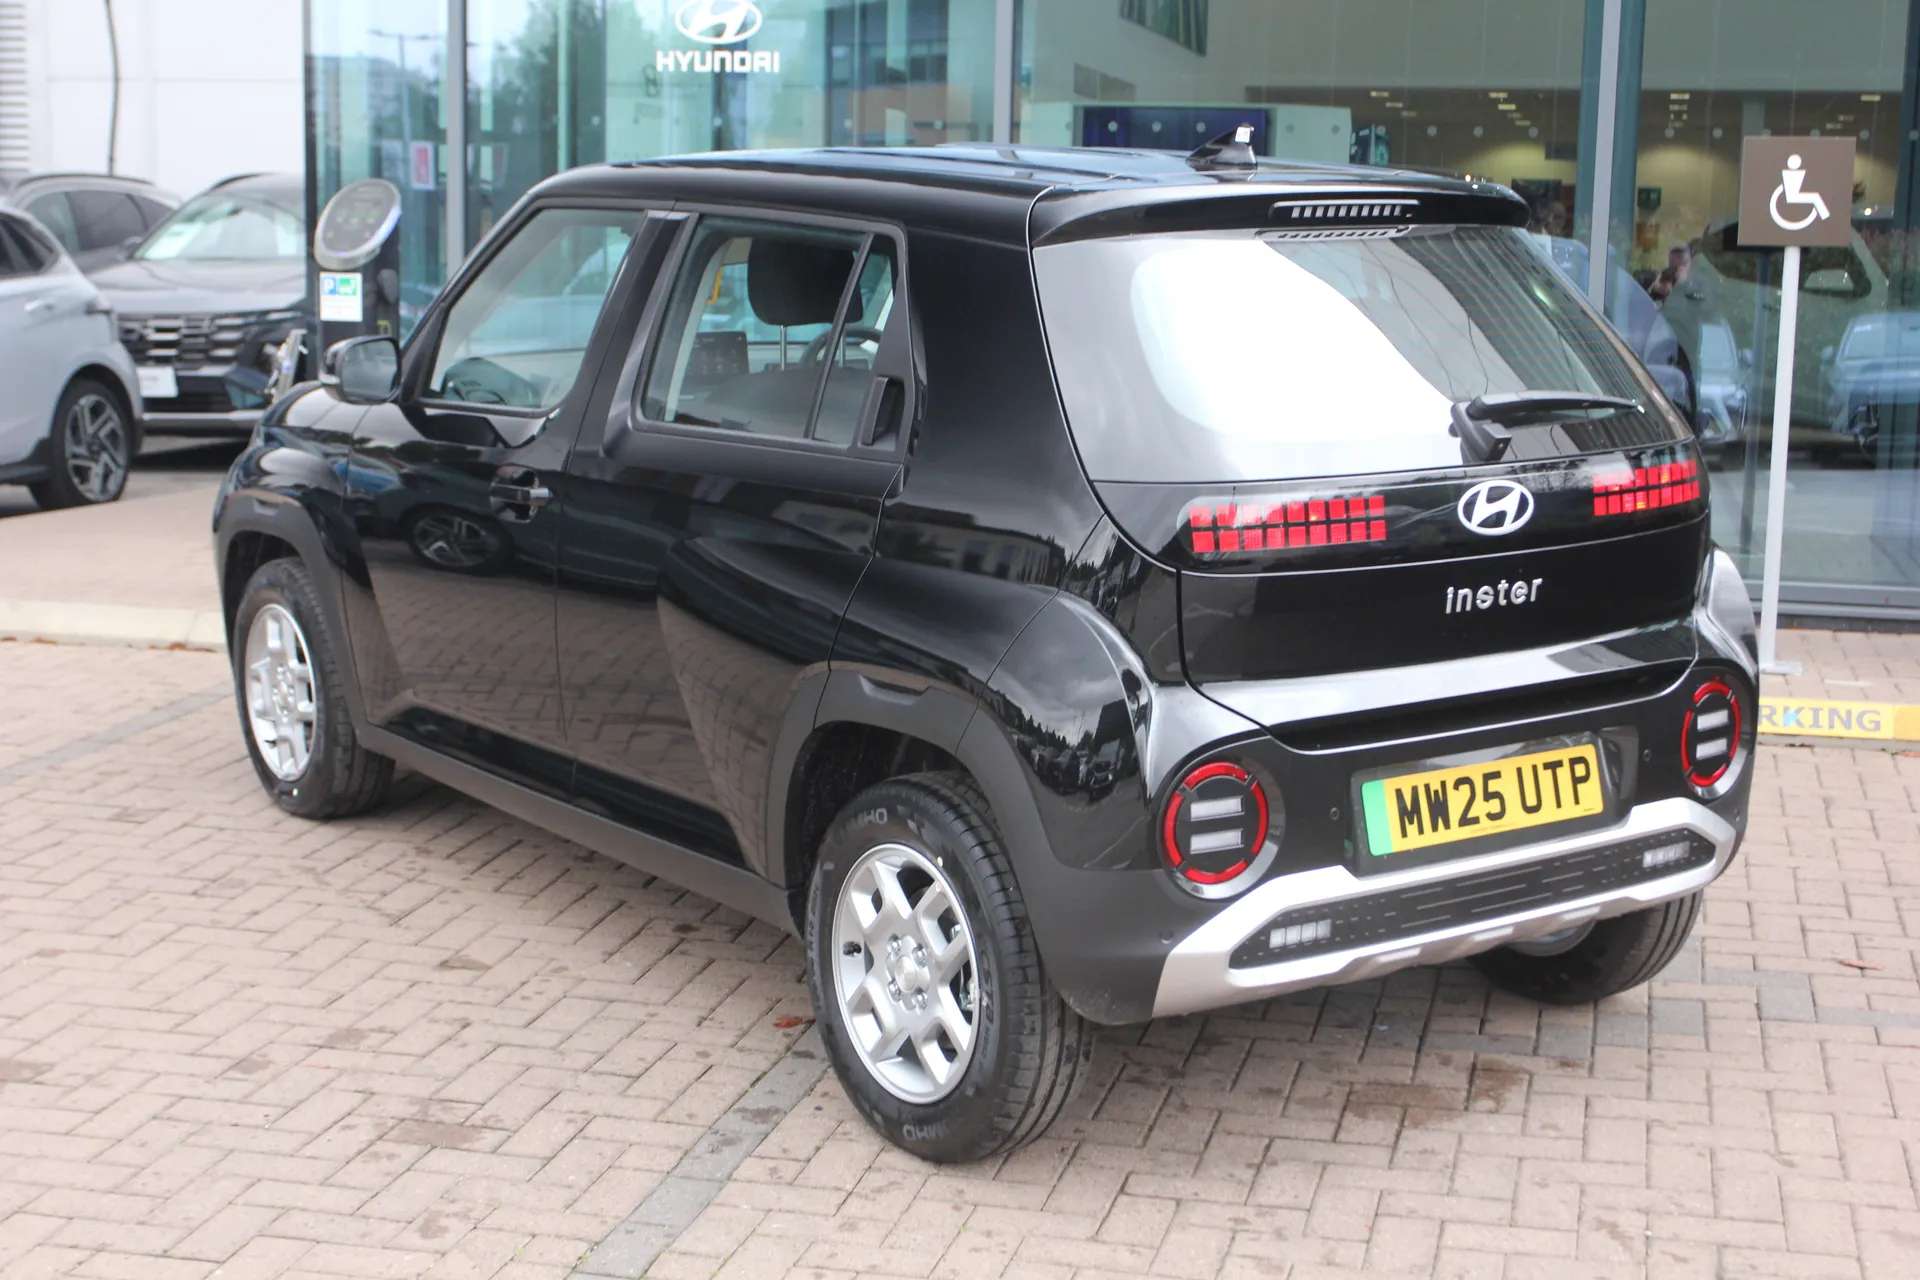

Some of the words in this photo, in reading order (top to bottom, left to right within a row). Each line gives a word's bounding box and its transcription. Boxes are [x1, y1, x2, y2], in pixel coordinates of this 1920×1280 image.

[656, 50, 780, 73] HYUNDAI
[1445, 578, 1543, 614] inster
[1394, 770, 1506, 839] MW25
[1516, 756, 1591, 814] UTP
